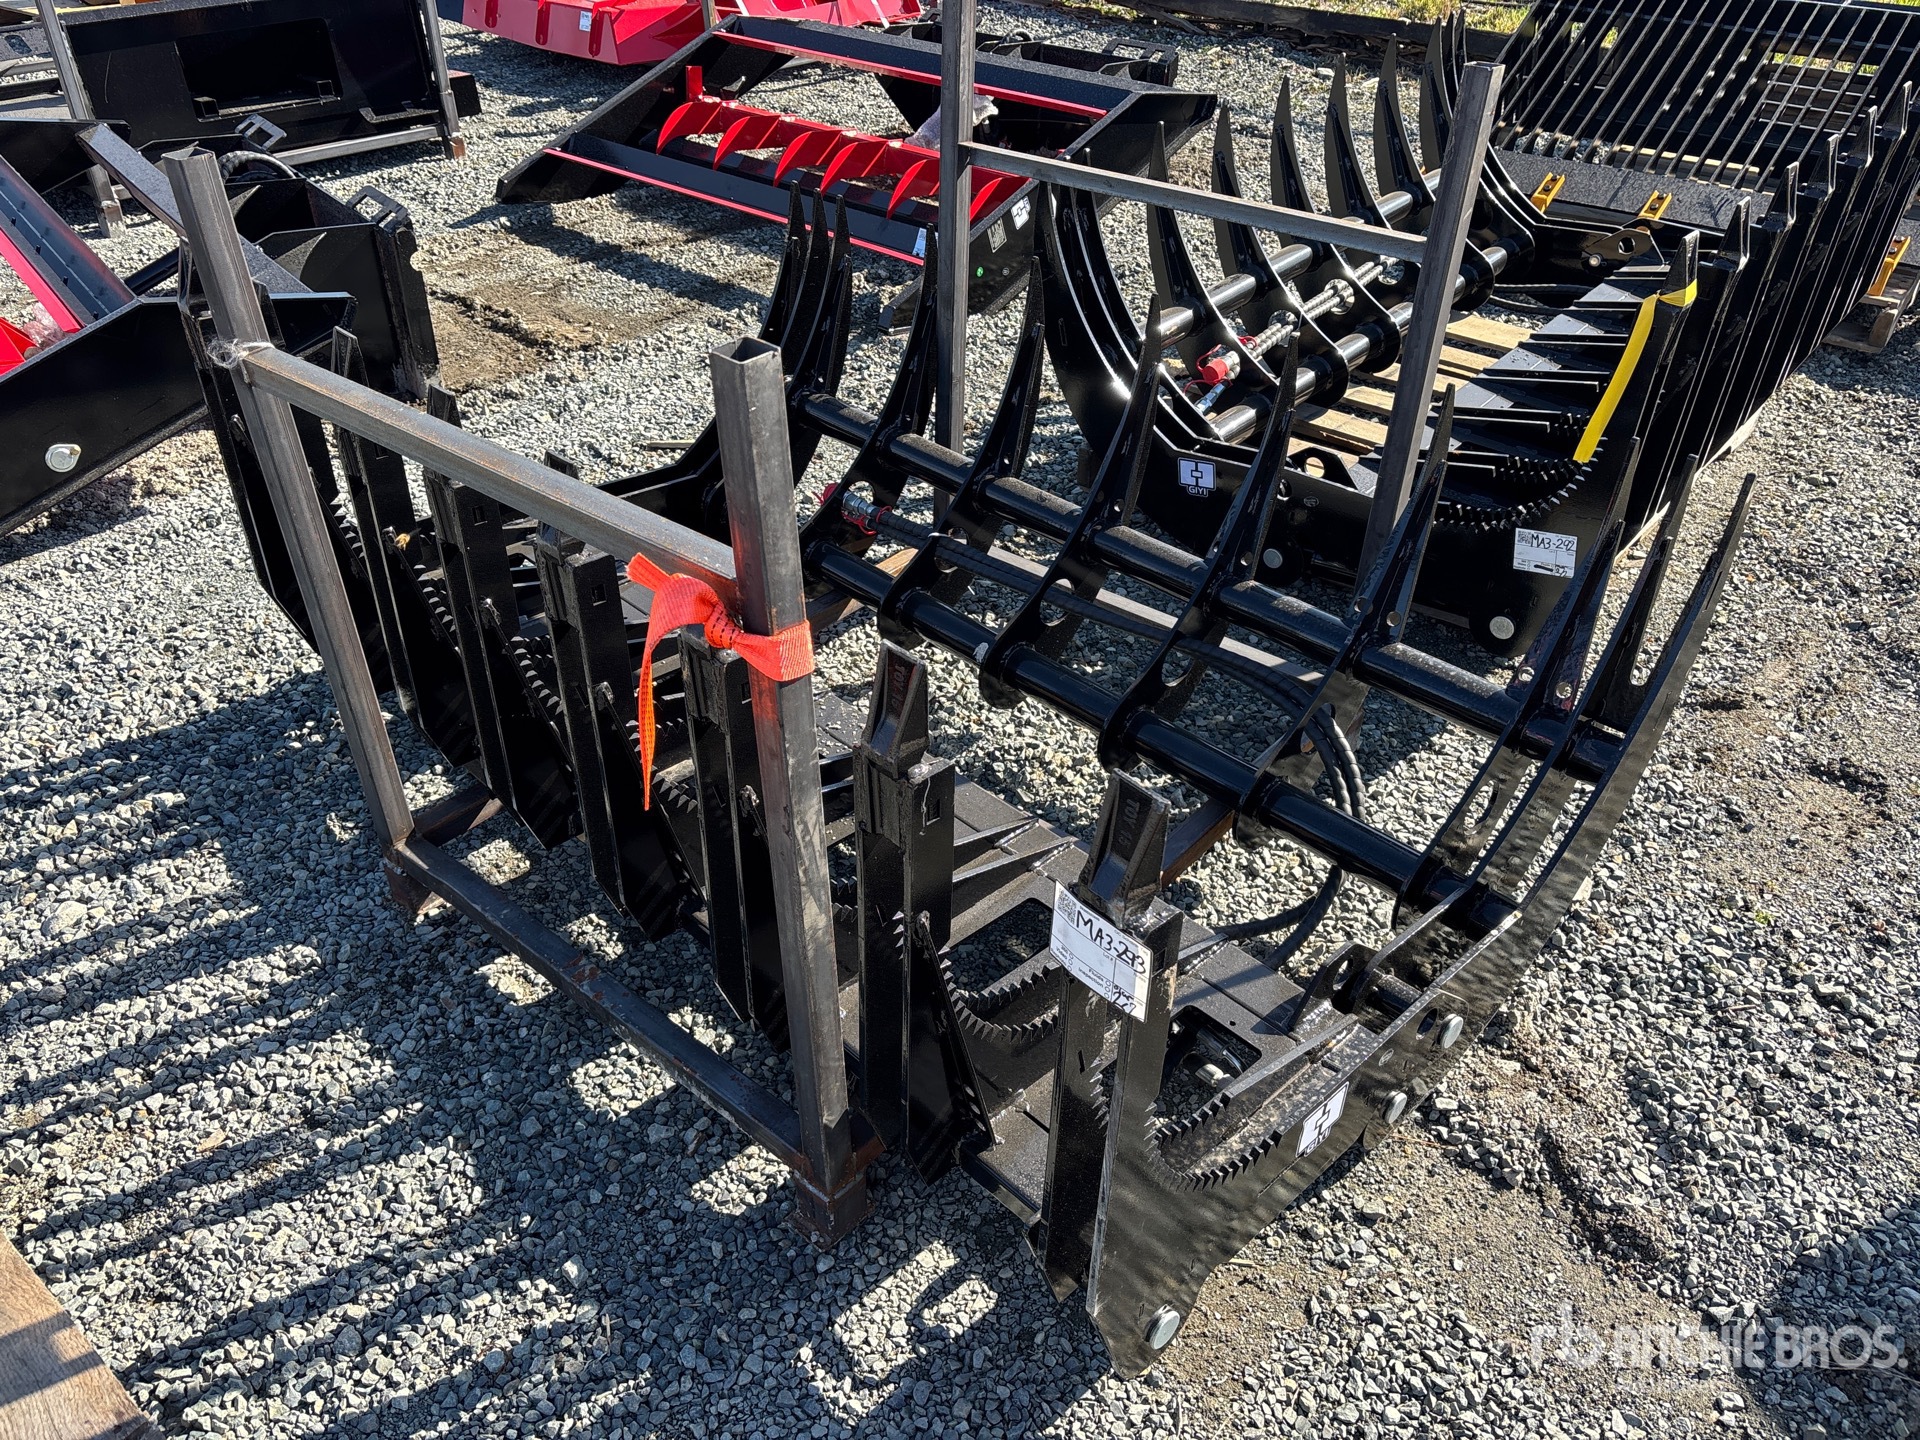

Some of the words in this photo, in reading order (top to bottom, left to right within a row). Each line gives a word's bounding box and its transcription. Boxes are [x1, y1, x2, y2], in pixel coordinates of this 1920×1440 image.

[1188, 486, 1206, 495] GIYI
[1531, 534, 1576, 551] MA3-292
[1075, 909, 1147, 975] MA3-293
[1078, 967, 1104, 988] Inspection
[1306, 1128, 1330, 1154] GIYI
